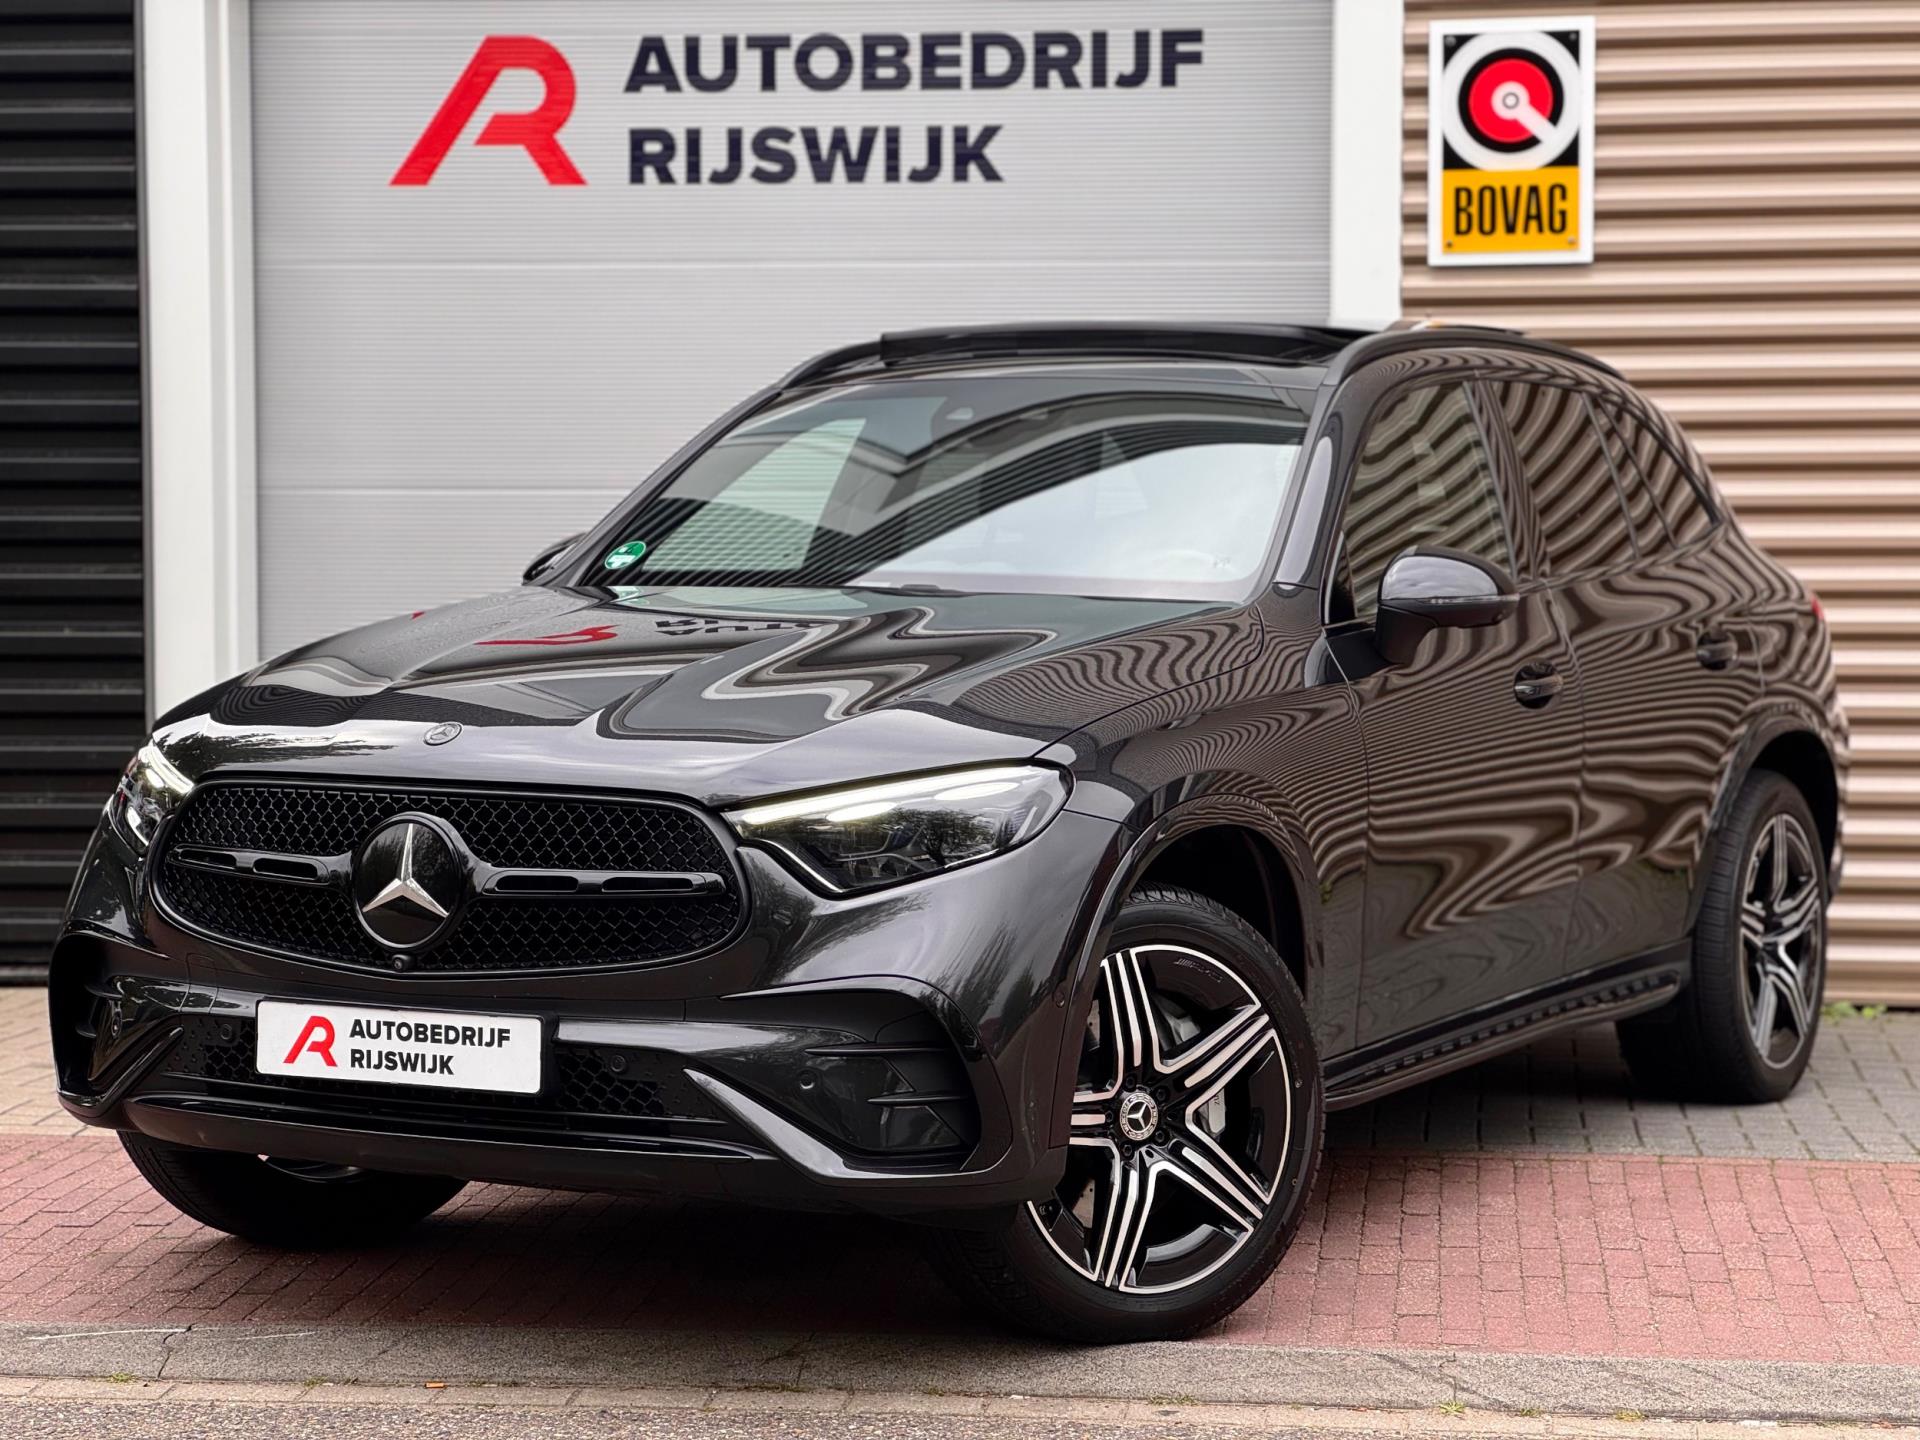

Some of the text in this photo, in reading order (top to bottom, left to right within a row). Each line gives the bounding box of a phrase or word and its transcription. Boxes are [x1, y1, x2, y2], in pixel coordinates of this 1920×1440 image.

[624, 29, 1203, 93] AUTOBEDRIJF
[629, 125, 1003, 185] RIJSWIJK
[1454, 183, 1568, 236] BOVAG
[349, 1018, 511, 1048] AUTOBEDRIJF
[350, 1048, 454, 1075] RIJSWIJK
